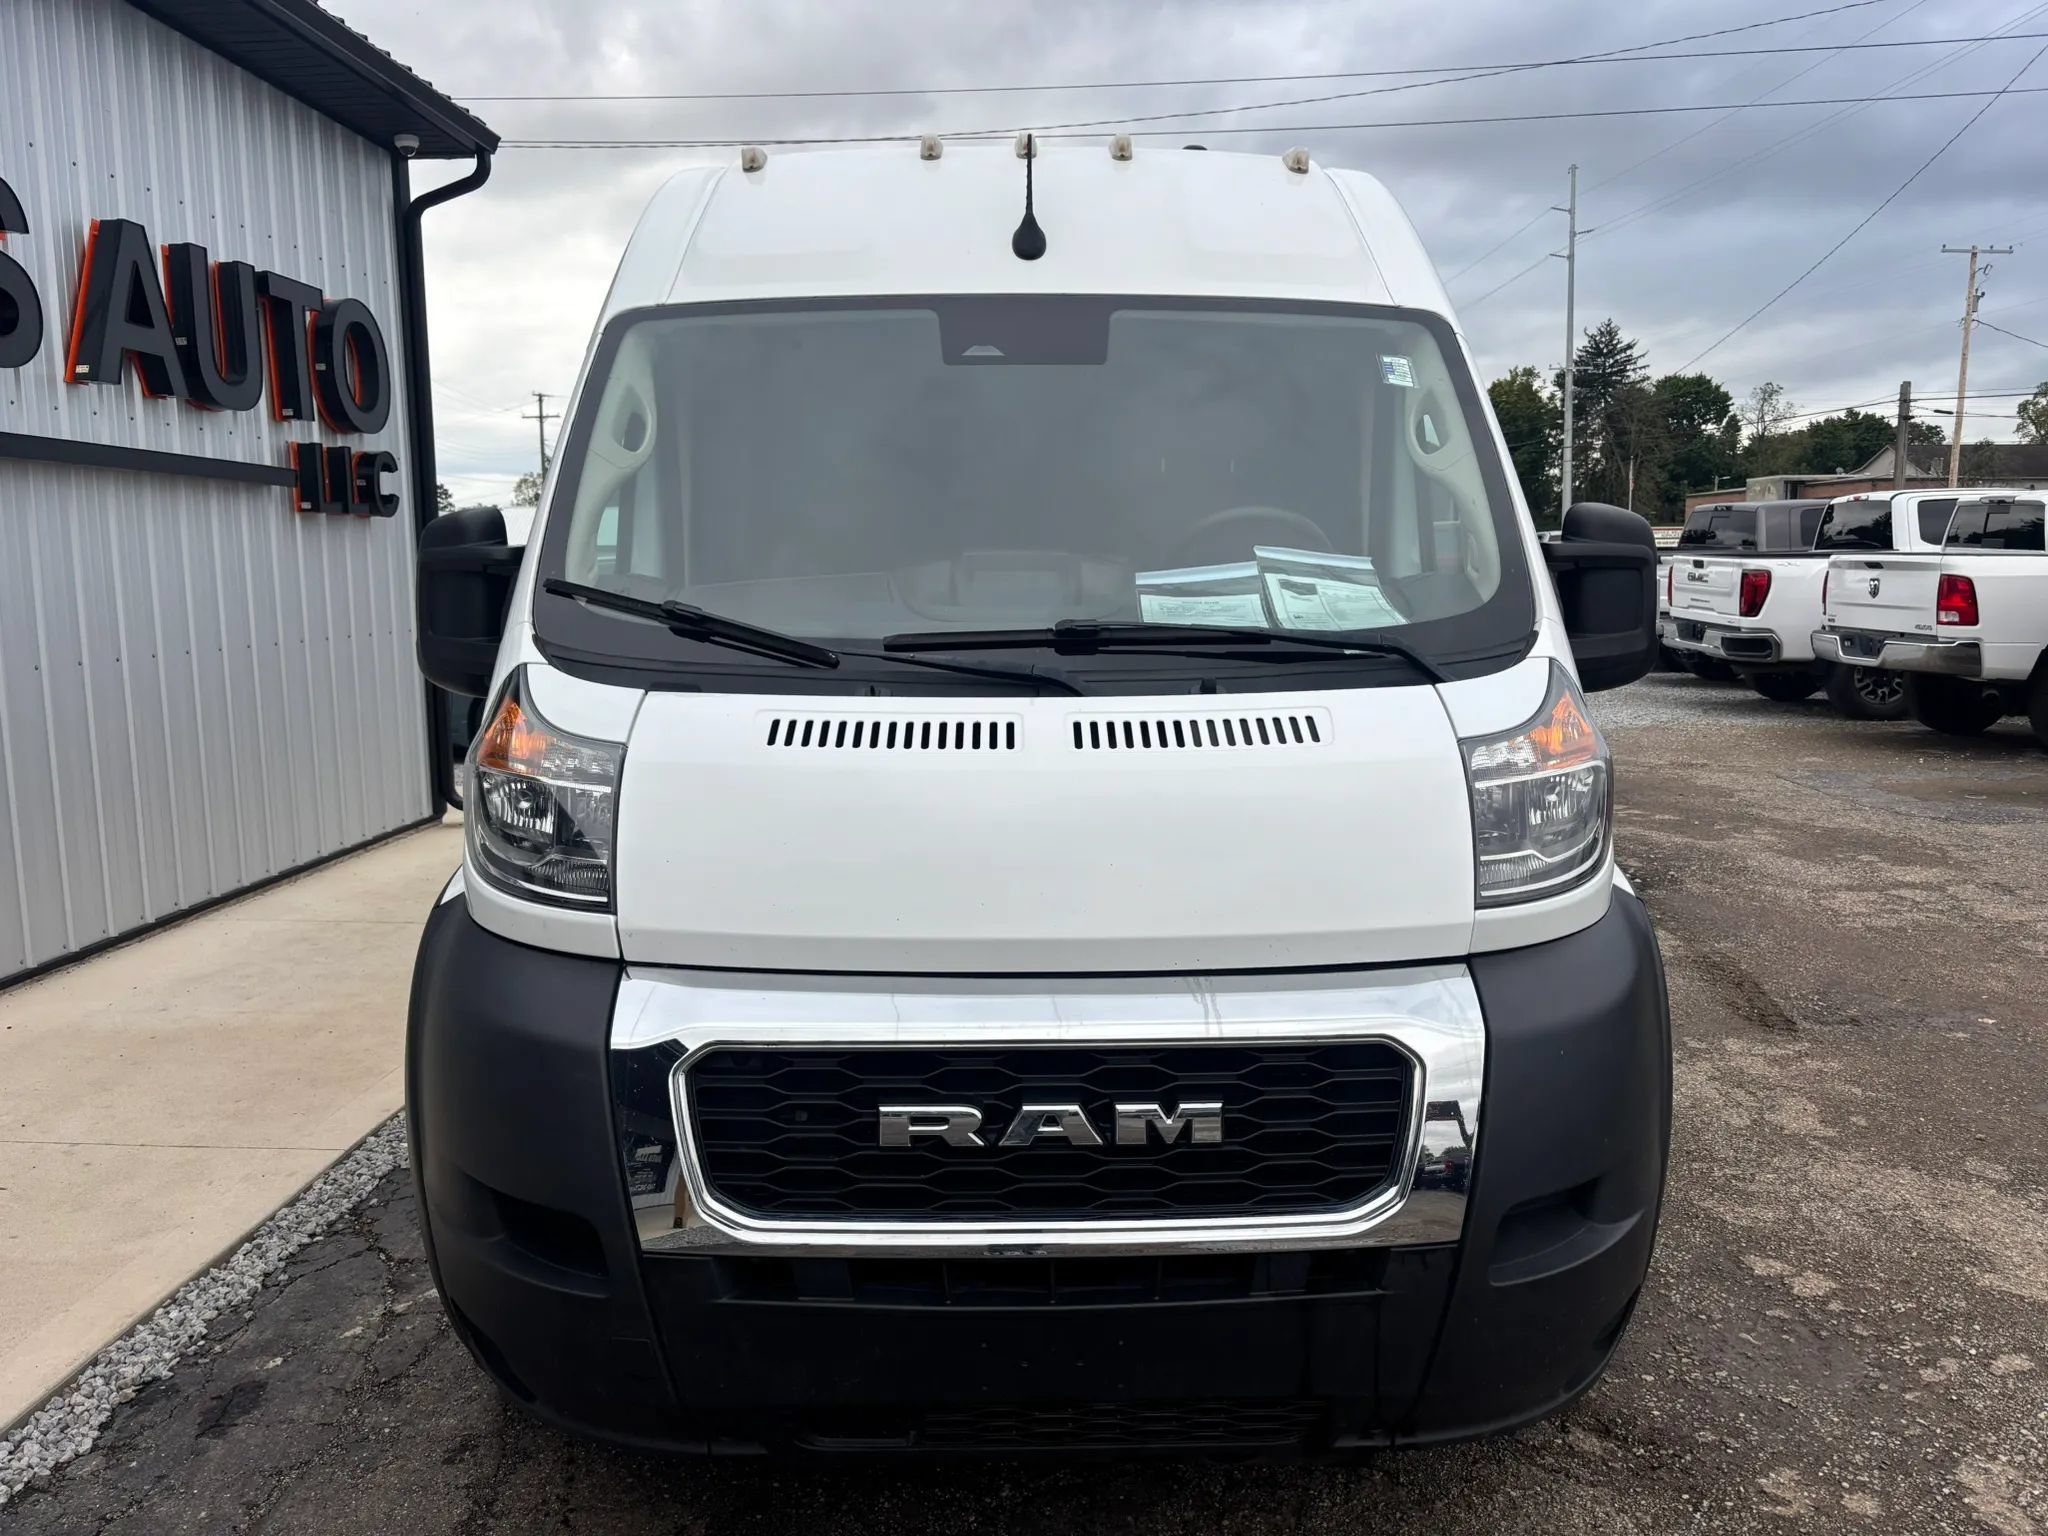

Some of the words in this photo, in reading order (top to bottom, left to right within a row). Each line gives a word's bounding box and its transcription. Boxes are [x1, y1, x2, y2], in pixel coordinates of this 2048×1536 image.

[66, 218, 391, 434] AUTO
[292, 441, 400, 518] LLC
[878, 1102, 1224, 1147] RAM
